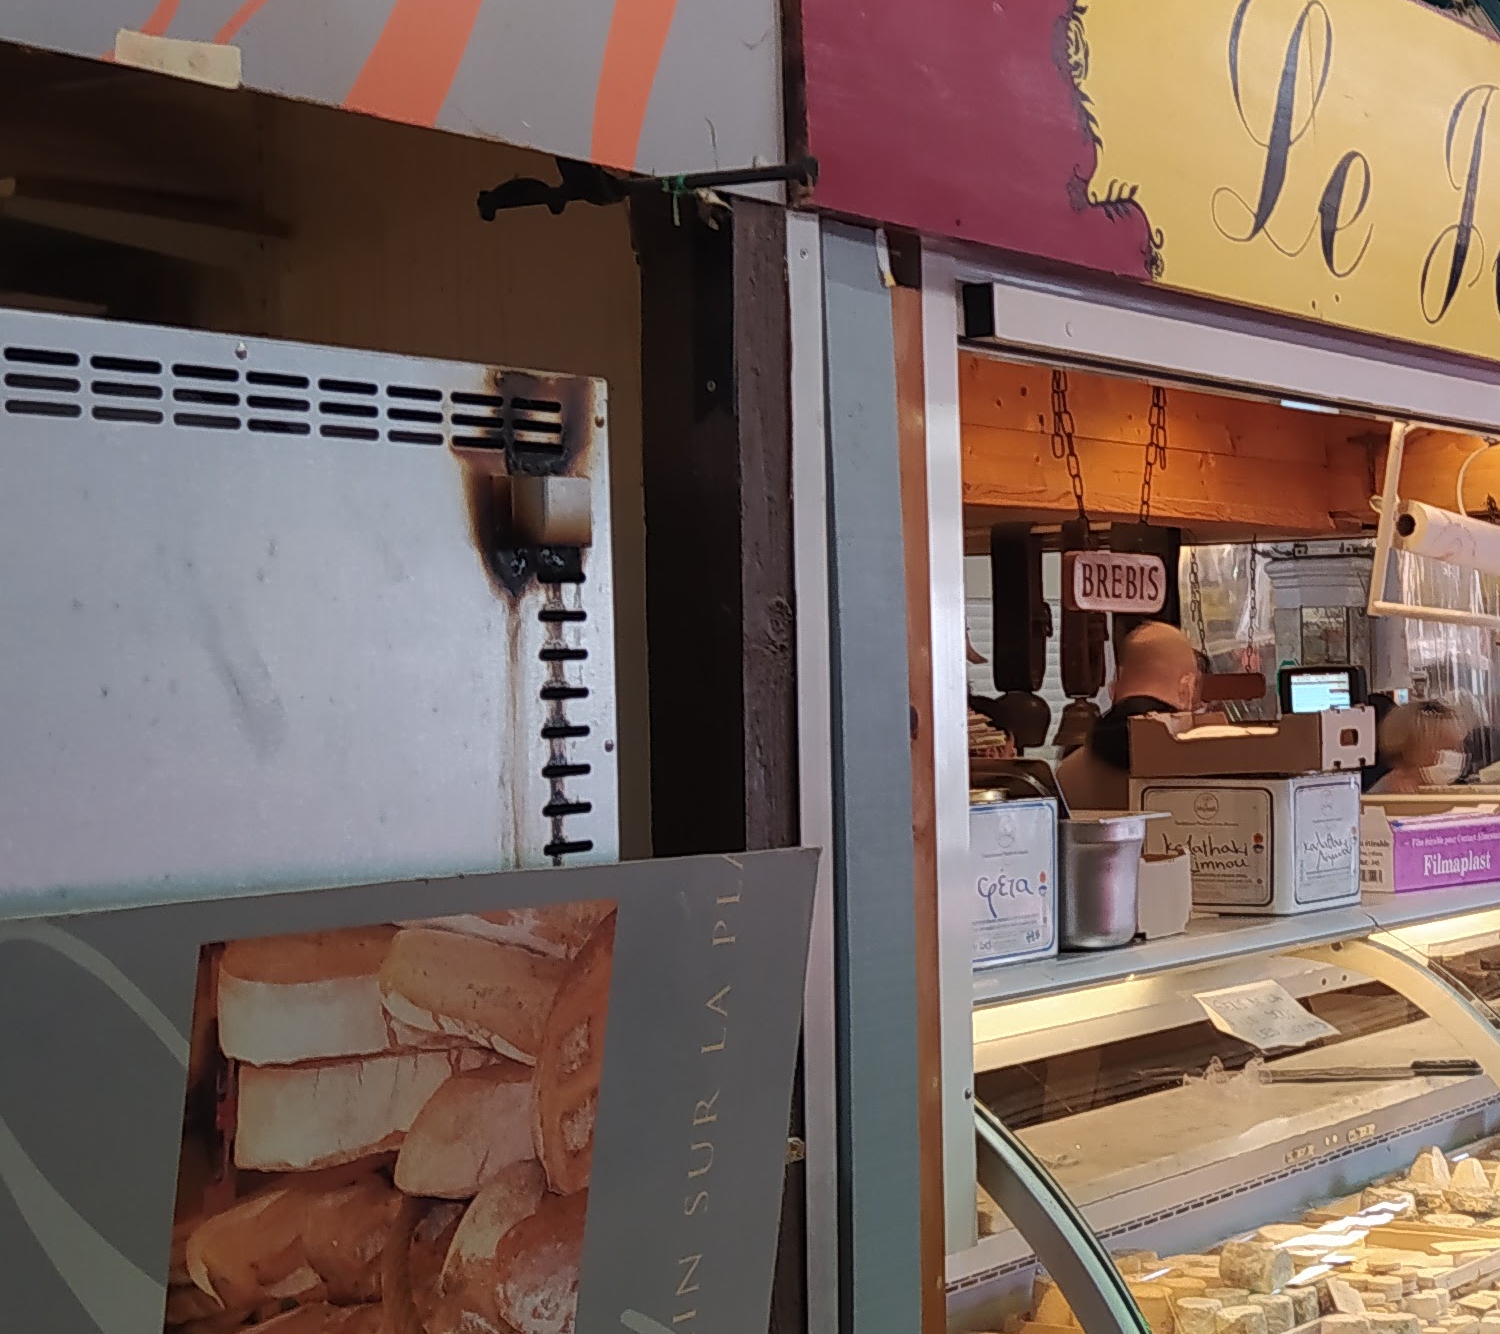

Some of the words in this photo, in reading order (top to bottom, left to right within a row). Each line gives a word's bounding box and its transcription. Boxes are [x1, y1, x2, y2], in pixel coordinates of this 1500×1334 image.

[1081, 563, 1159, 601] BREBIS
[1423, 850, 1491, 877] Filmaplast
[700, 983, 732, 1054] LA
[684, 1088, 720, 1217] SUR
